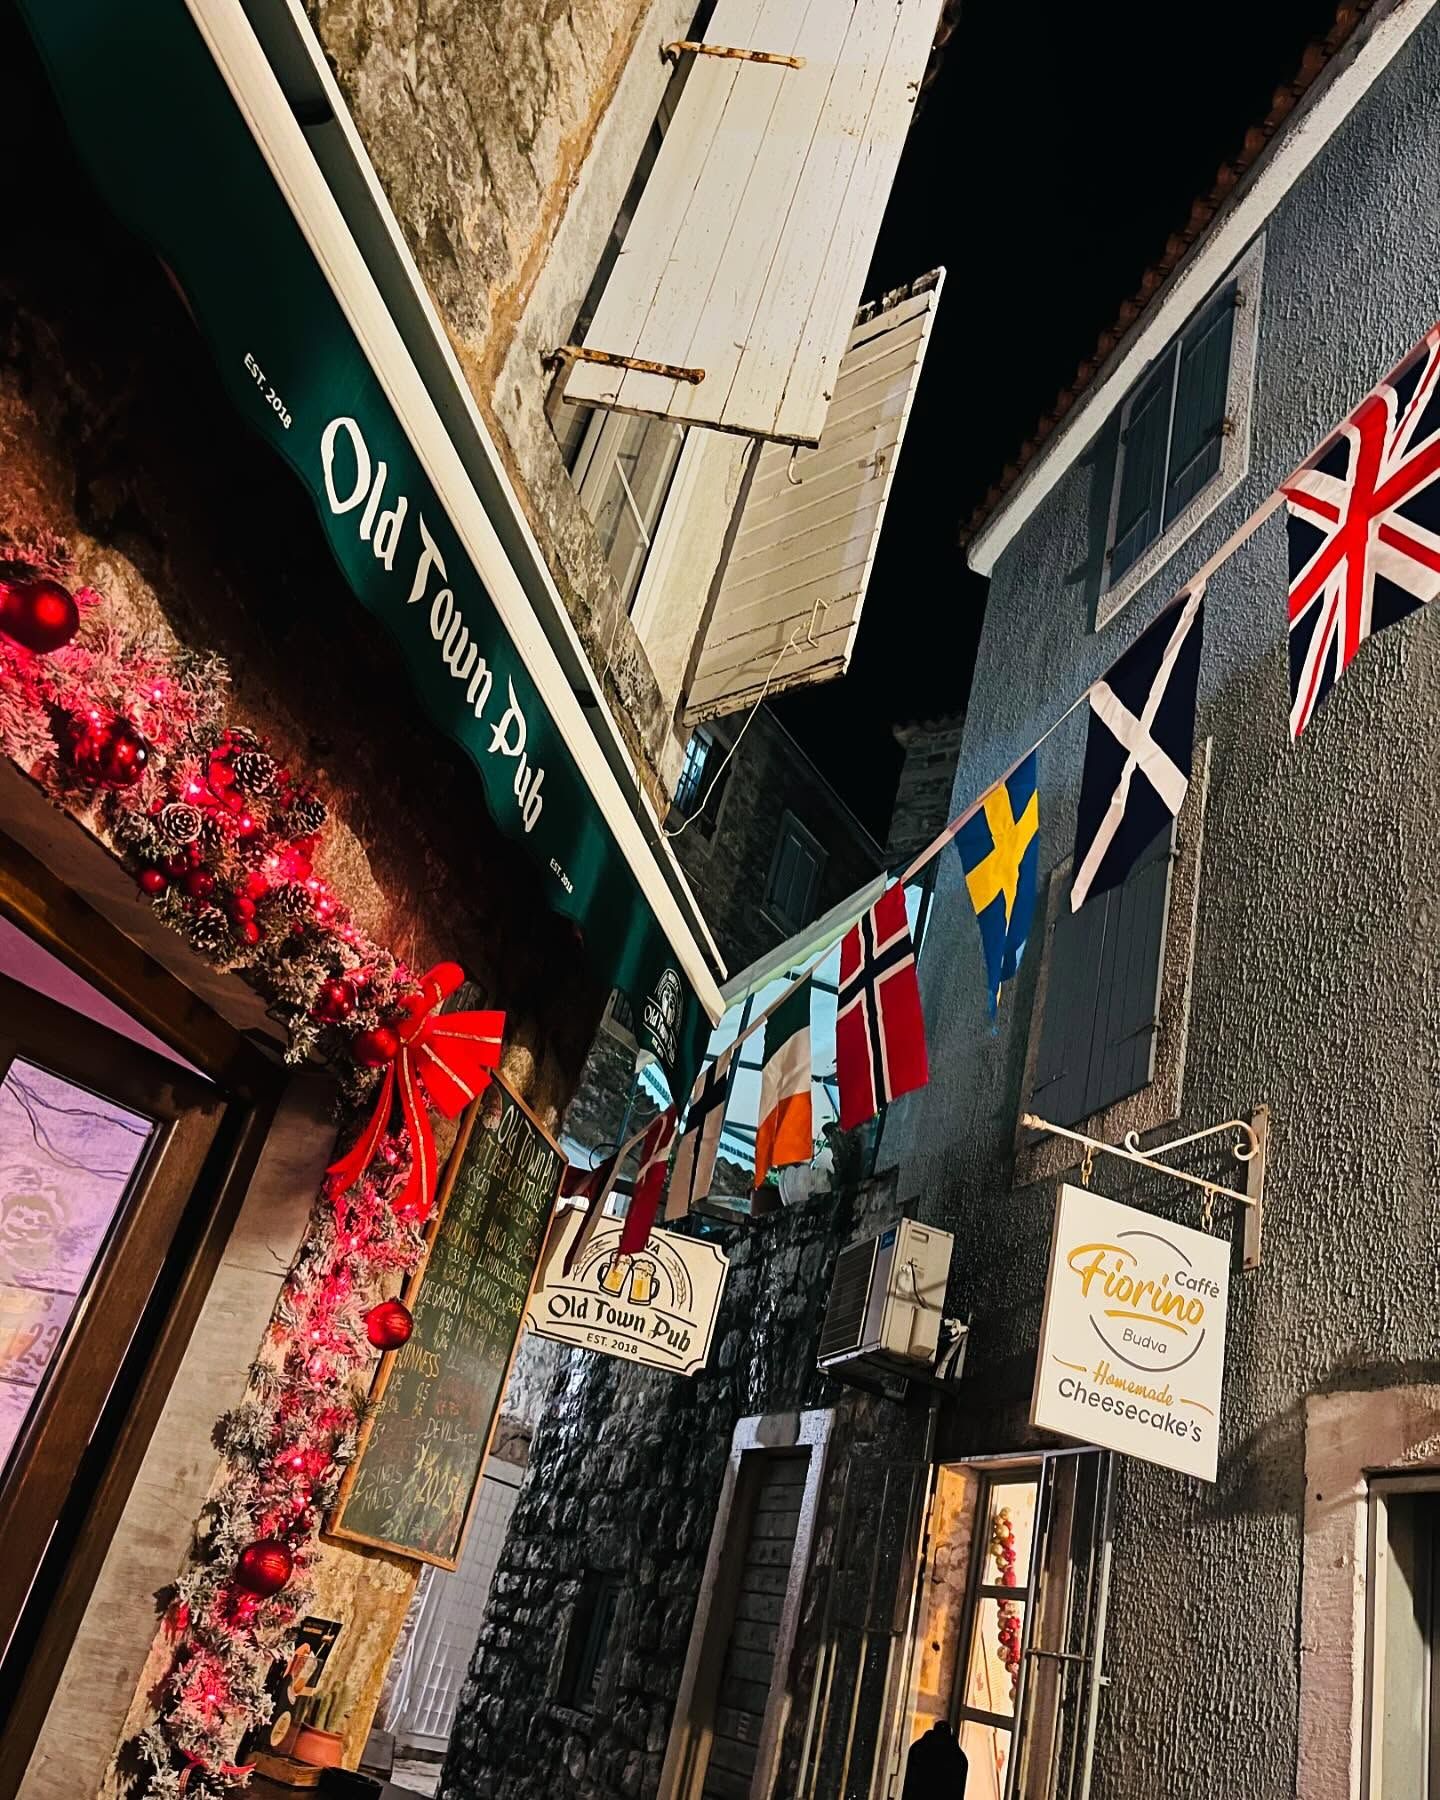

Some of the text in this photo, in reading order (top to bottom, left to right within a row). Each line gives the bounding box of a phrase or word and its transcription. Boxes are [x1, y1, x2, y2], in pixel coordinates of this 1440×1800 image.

[244, 352, 292, 429] EST. 2018
[320, 416, 545, 833] Old Town Pub
[550, 858, 562, 877] EST.
[1067, 1243, 1205, 1325] Fiorino
[1174, 1270, 1220, 1299] Caffè
[548, 1294, 691, 1352] Old Town Pub
[586, 1332, 638, 1354] EST. 2018
[1122, 1327, 1168, 1354] Budva
[1092, 1359, 1175, 1407] Homemade
[1057, 1378, 1203, 1443] Cheesecake's
[415, 1467, 461, 1516] 2025
